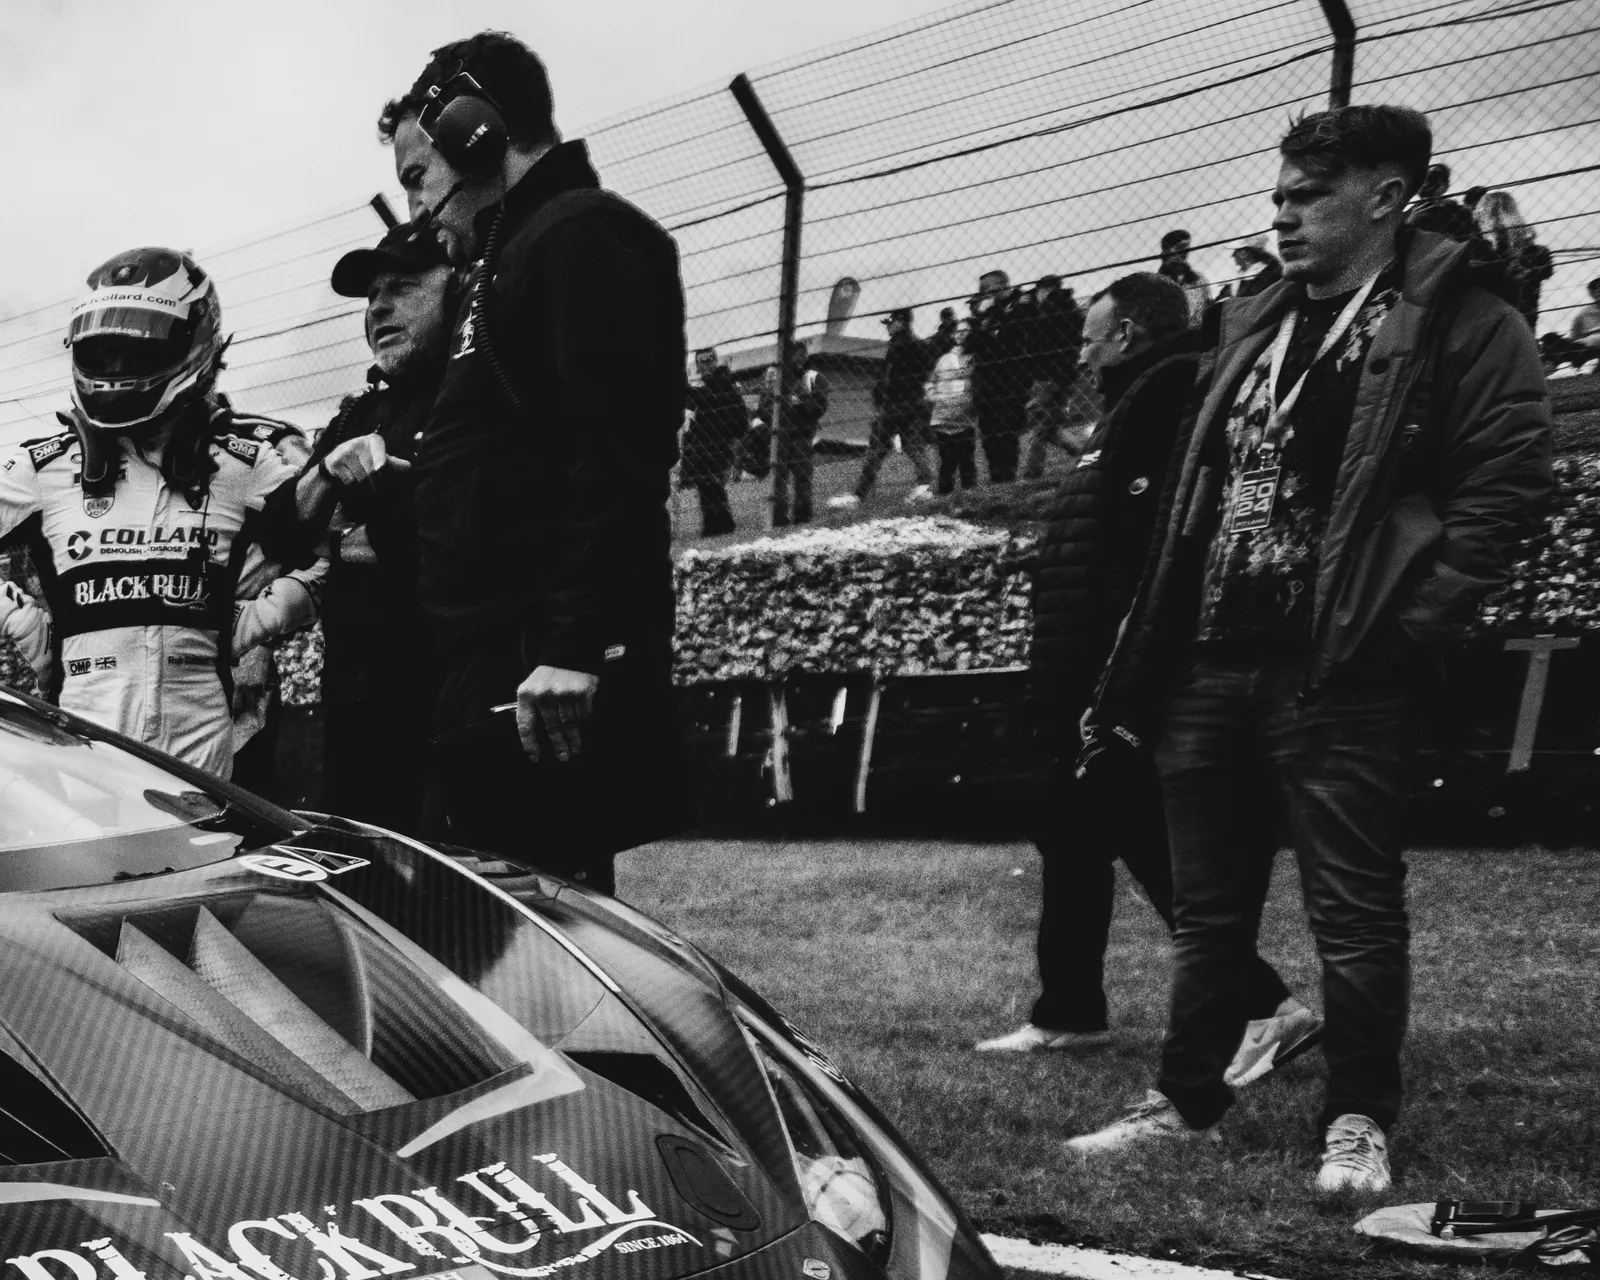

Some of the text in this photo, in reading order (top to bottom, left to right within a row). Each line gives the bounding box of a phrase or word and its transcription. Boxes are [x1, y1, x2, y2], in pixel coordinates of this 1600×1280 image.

[33, 442, 61, 459] OMP
[228, 440, 256, 456] OMP
[75, 575, 150, 606] BLACK
[69, 660, 92, 674] OMP
[352, 1153, 656, 1264] BULL
[613, 1230, 689, 1256] SINCE 1864
